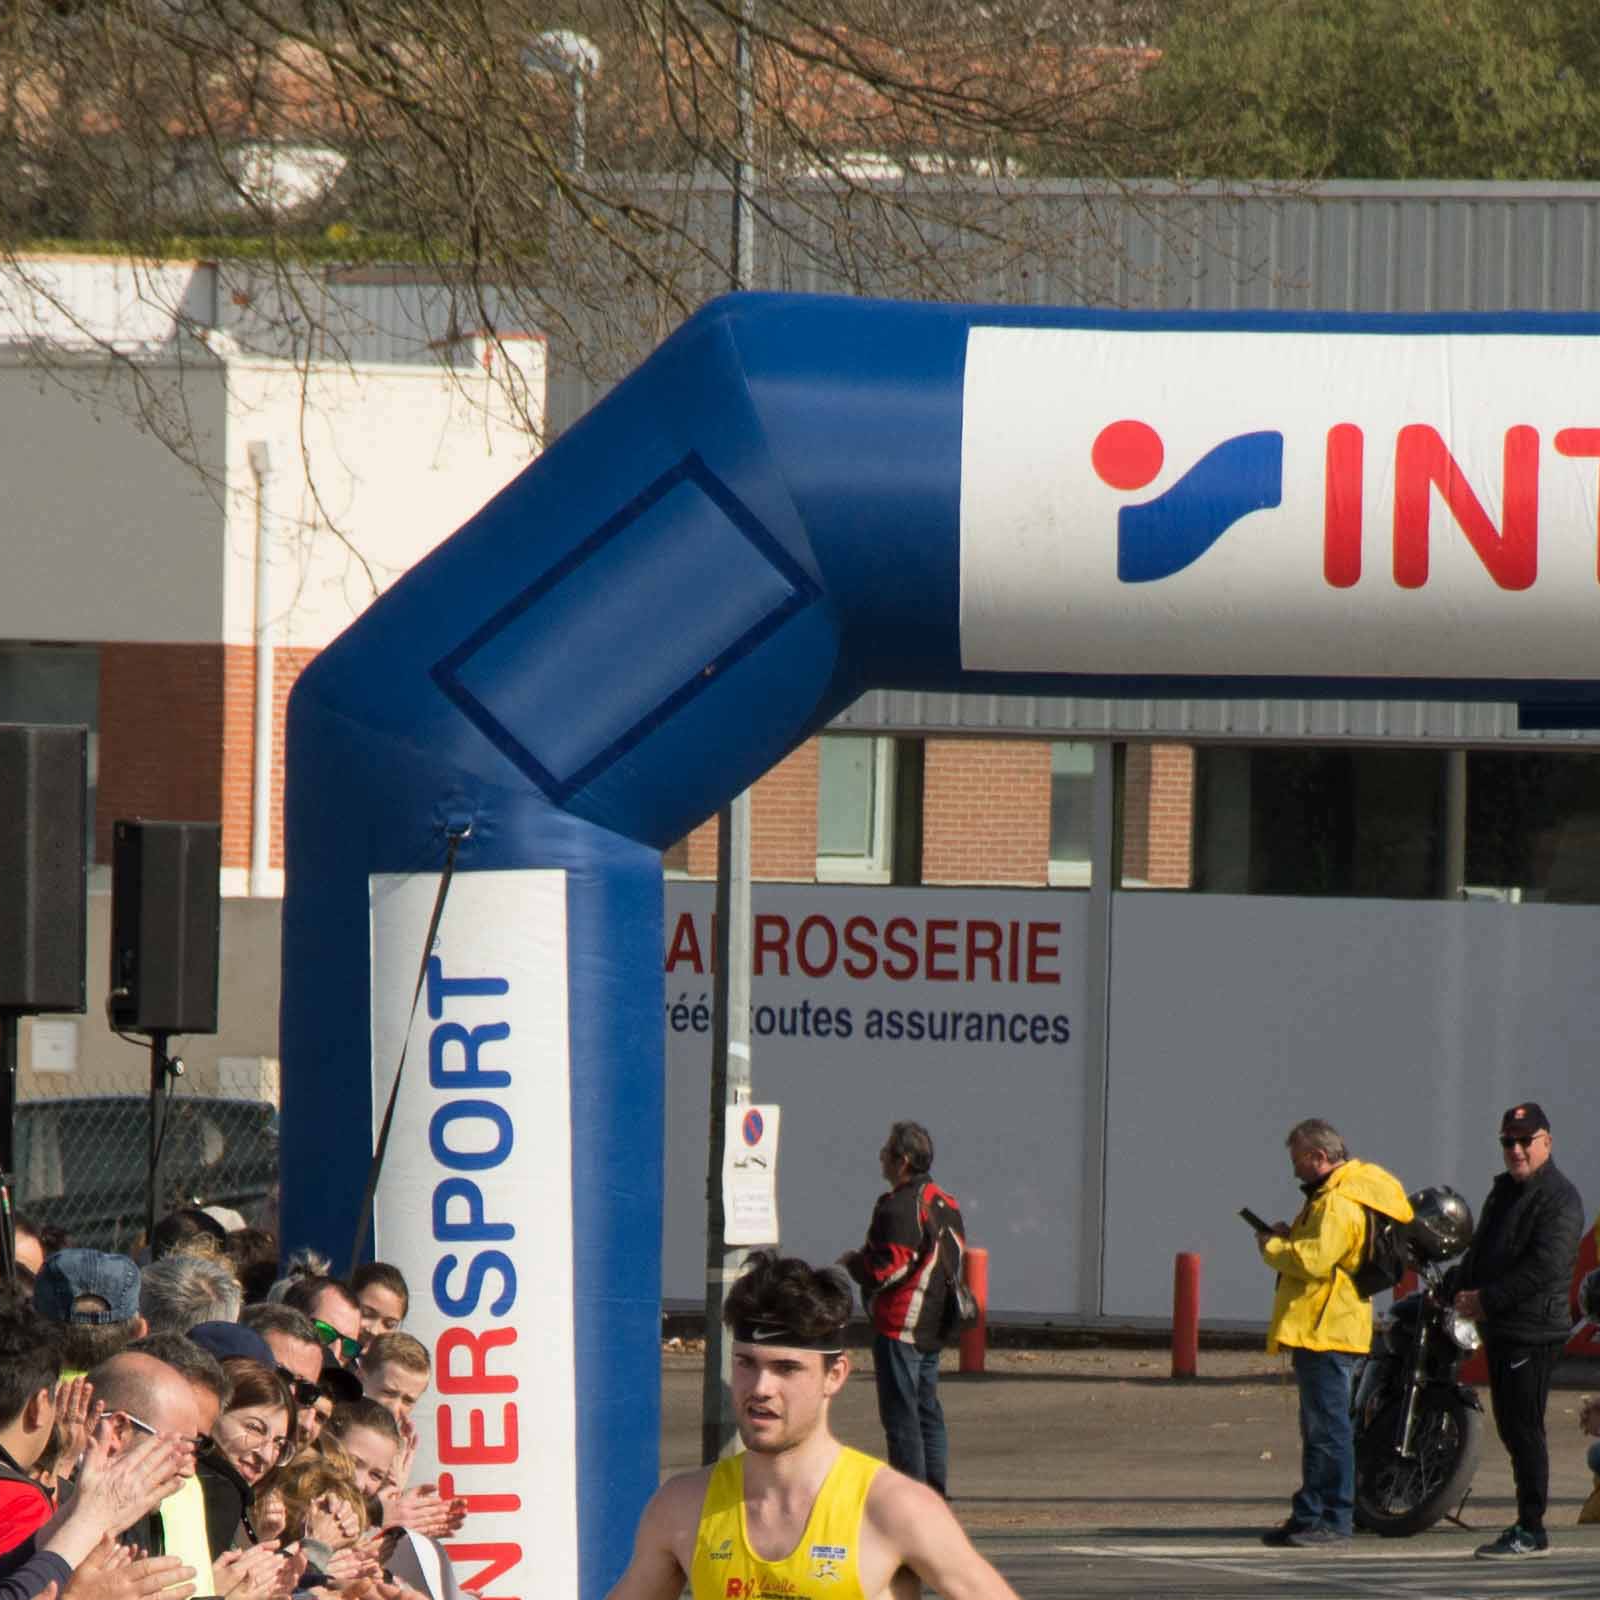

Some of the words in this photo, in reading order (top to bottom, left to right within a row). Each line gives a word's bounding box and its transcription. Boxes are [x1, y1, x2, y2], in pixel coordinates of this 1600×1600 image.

[664, 911, 1061, 984] AROSSERIE
[746, 999, 853, 1038] outes
[864, 1004, 1071, 1044] assurances
